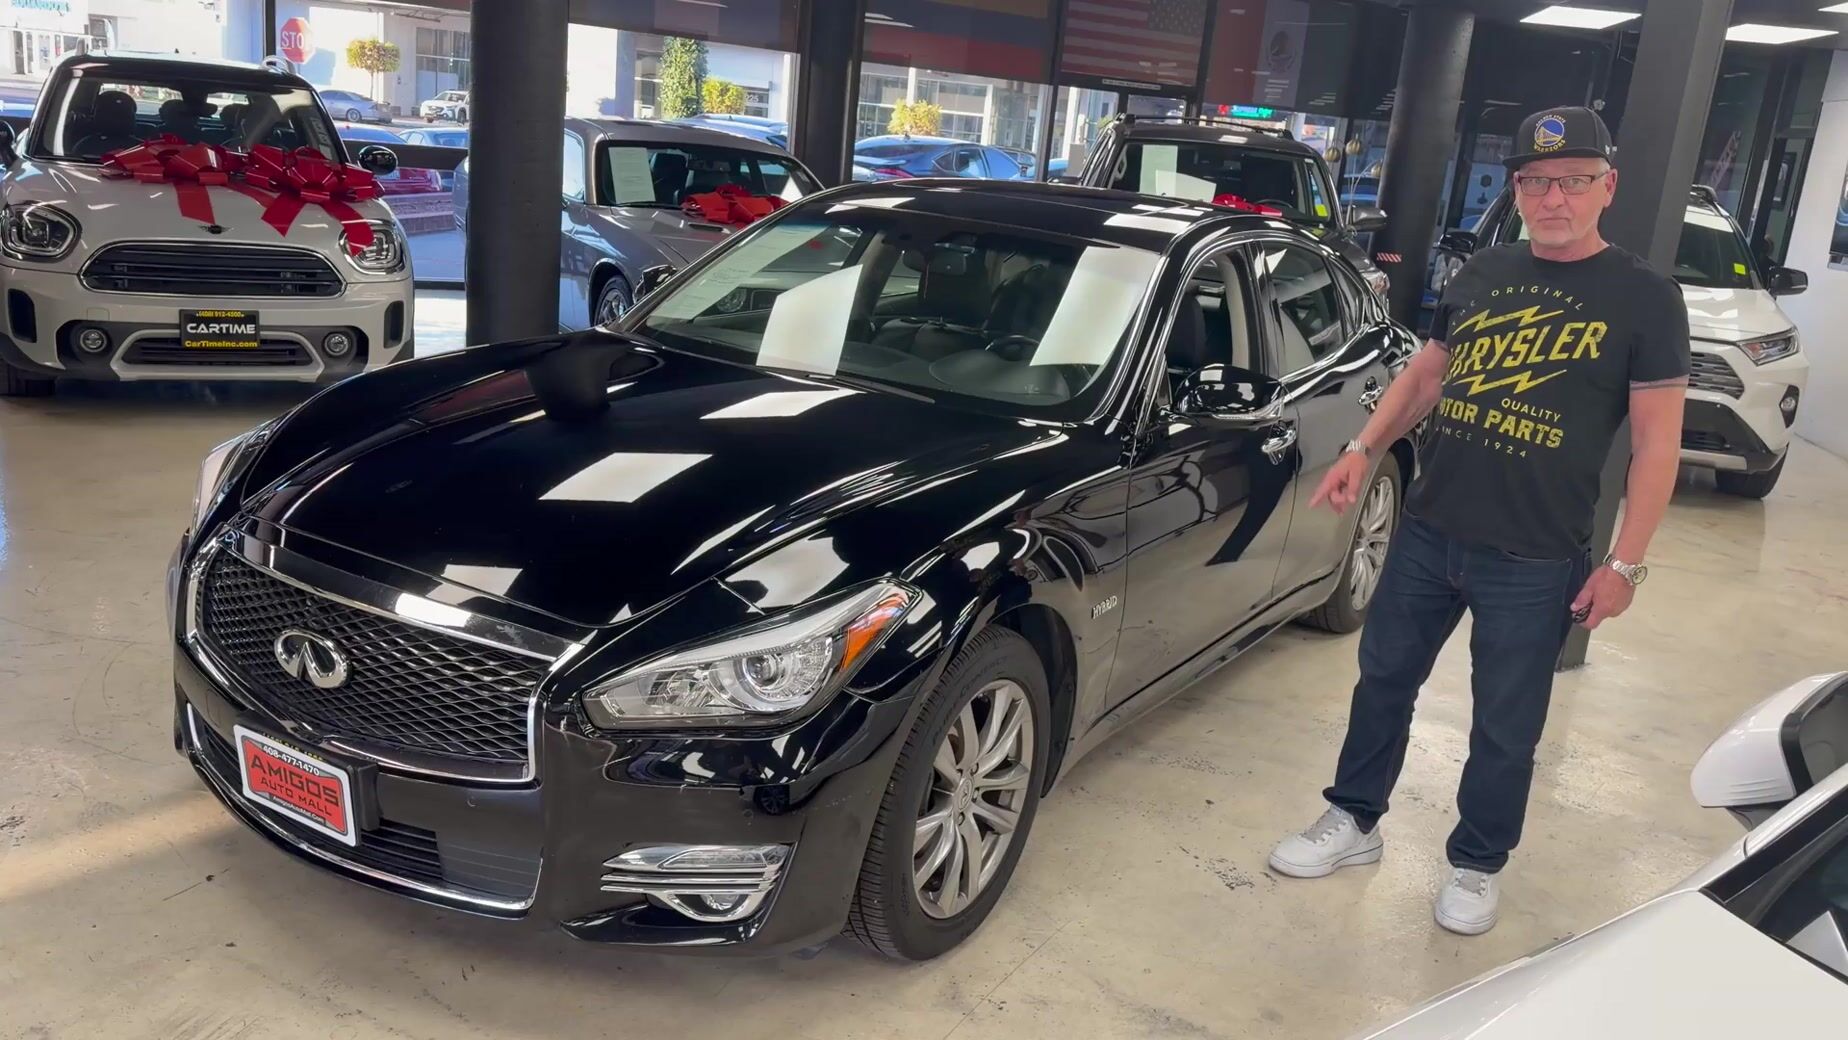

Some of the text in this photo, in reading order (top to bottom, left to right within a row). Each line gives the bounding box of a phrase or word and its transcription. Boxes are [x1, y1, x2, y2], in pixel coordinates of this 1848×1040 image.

[282, 31, 306, 49] STO
[1491, 285, 1584, 311] ORIGINAL
[186, 323, 256, 334] CARTIME
[1501, 397, 1561, 423] QUALITY
[1483, 408, 1564, 449] PARTS
[1484, 438, 1527, 458] 1924
[263, 745, 320, 776] 408-477-1470
[251, 754, 339, 807] AMIGOS
[260, 777, 332, 816] AUTO MALL
